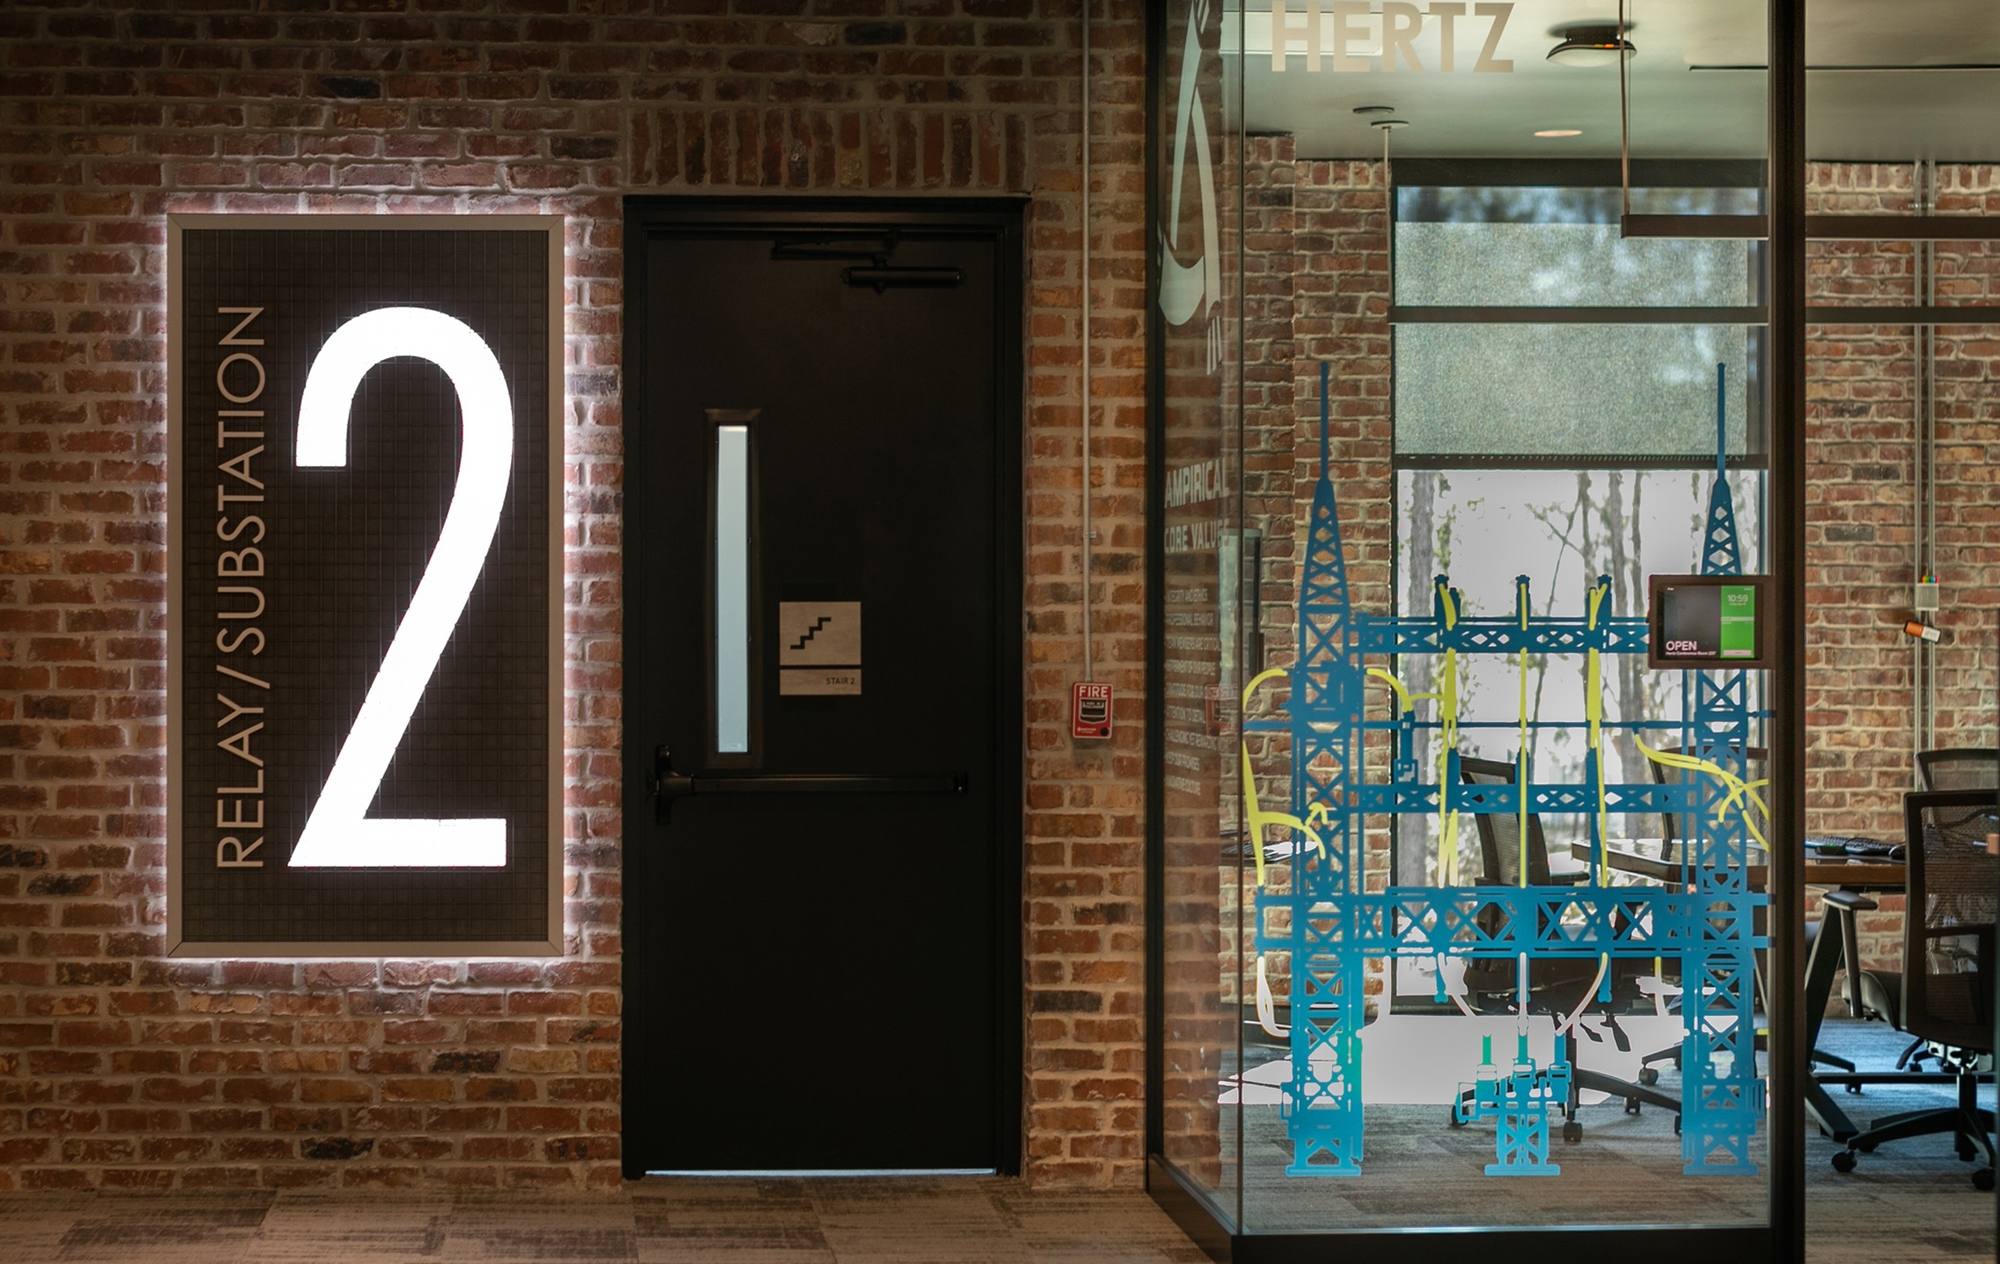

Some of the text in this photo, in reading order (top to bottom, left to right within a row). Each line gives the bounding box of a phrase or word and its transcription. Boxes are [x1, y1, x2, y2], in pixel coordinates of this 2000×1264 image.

[1271, 1, 1515, 73] HERTZ
[1164, 457, 1230, 509] AMPIRICAL
[1164, 518, 1229, 553] CORE VALUES
[287, 305, 514, 868] 2
[1666, 641, 1697, 651] OPEN
[825, 677, 855, 685] STAIR 2
[1079, 686, 1108, 698] FIRE
